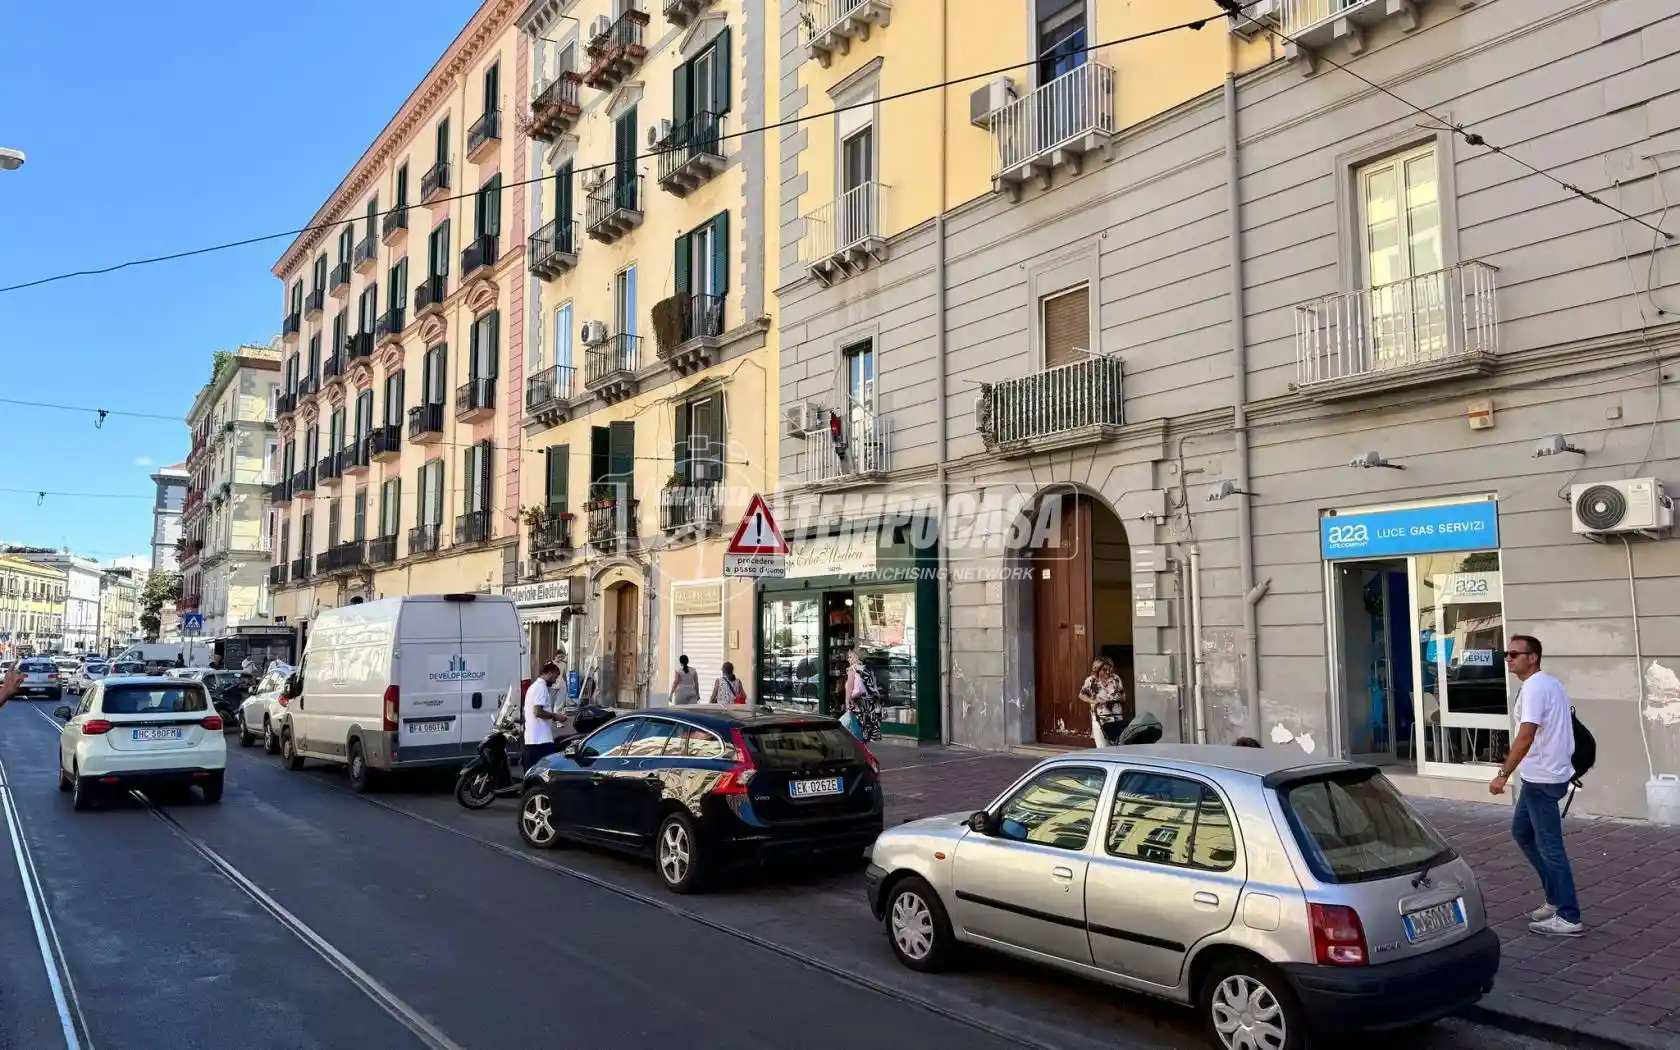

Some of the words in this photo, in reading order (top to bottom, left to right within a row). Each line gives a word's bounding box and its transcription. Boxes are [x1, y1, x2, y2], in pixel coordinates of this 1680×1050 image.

[1328, 524, 1369, 543] a2a
[1377, 528, 1405, 538] LUCE
[1410, 525, 1434, 536] GAS
[1438, 520, 1485, 533] SERVIZI
[737, 557, 775, 565] procedere
[734, 566, 757, 574] passo
[537, 582, 569, 600] Elettrico
[1456, 579, 1488, 592] a2a
[429, 672, 461, 680] DEVELOP
[461, 671, 486, 679] GROUP
[796, 781, 809, 794] EK
